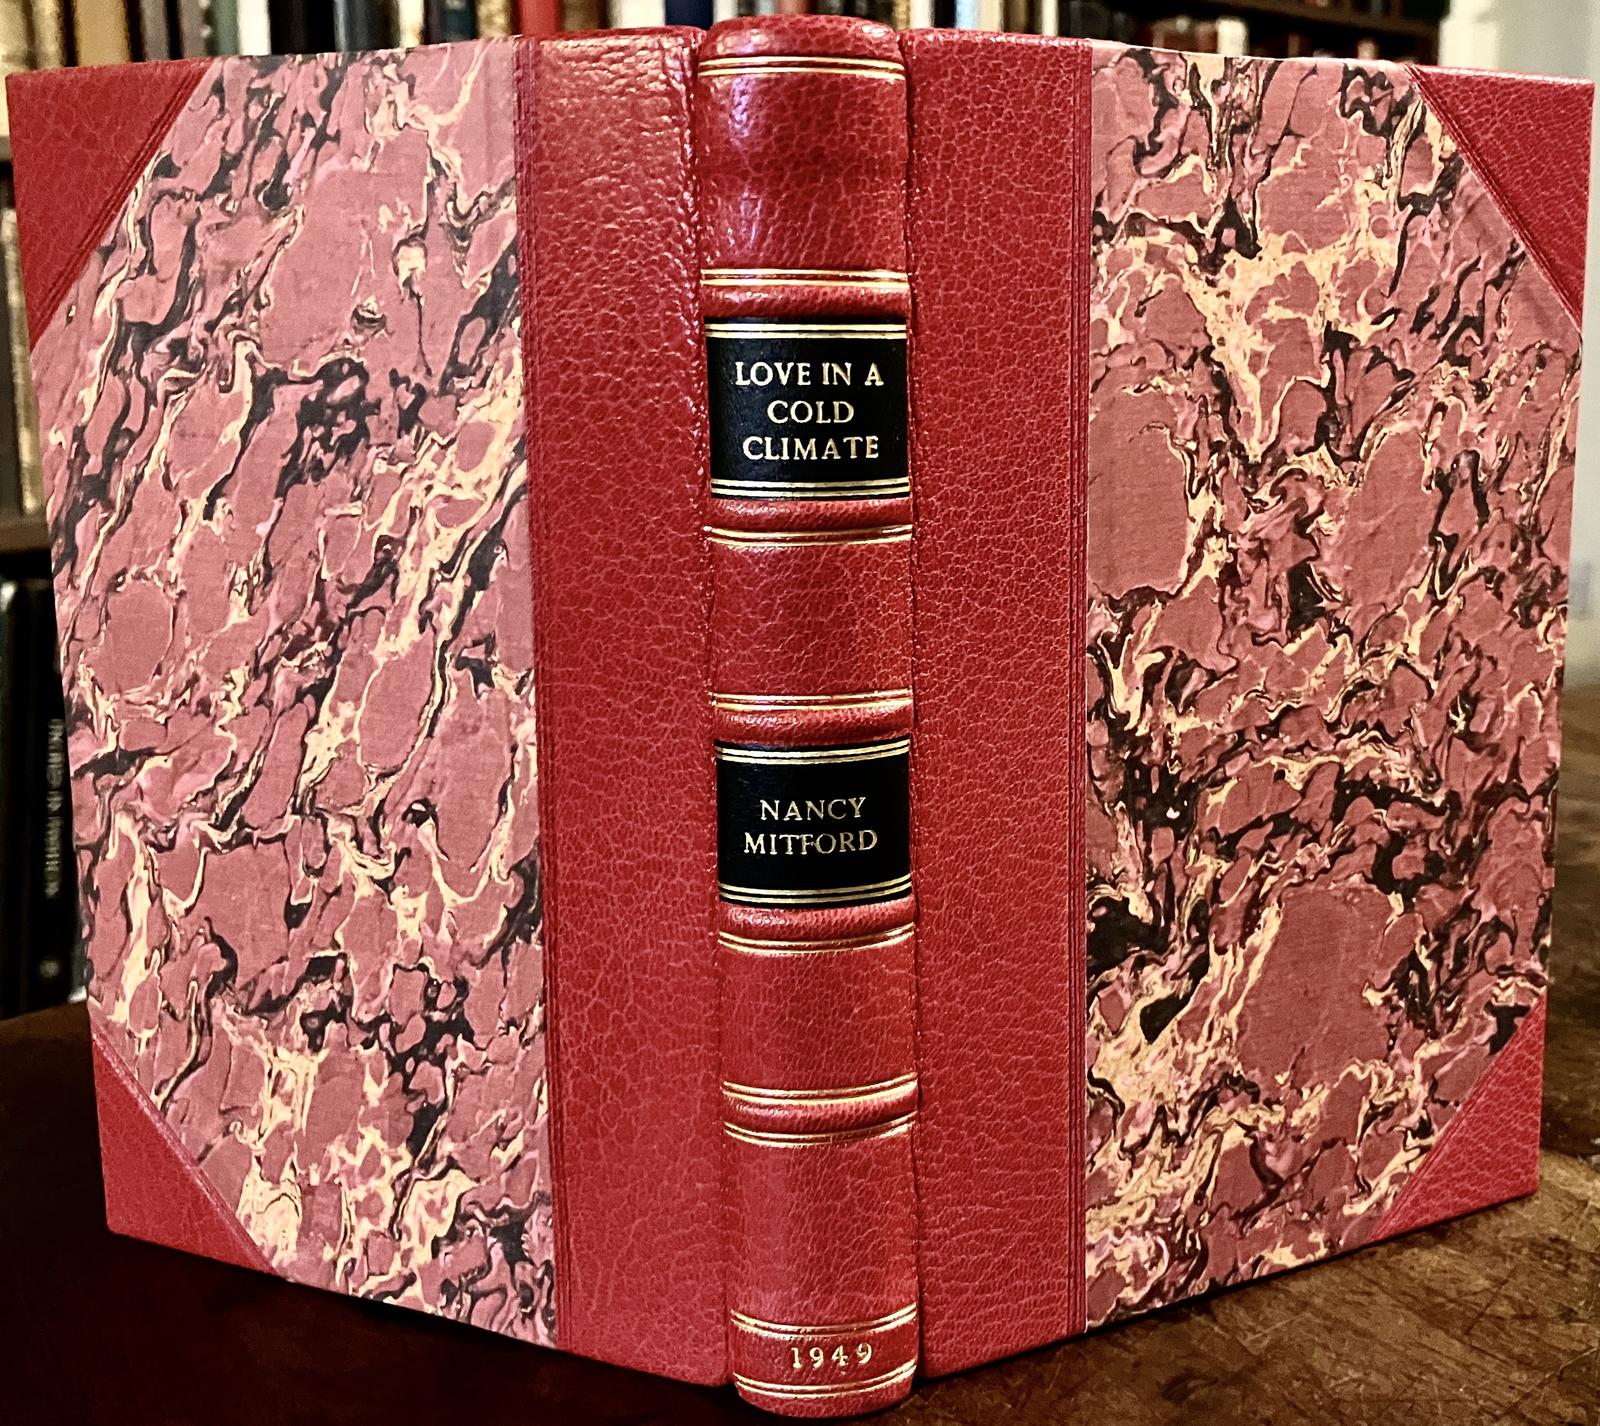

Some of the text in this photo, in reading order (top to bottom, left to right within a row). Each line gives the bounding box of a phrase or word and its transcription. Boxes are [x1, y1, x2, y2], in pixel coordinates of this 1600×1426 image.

[735, 361, 885, 386] LOVE IN A
[767, 400, 854, 424] COLD
[742, 436, 879, 460] CLIMATE
[760, 796, 867, 821] NANCY
[743, 830, 878, 855] MITFORD
[791, 1343, 872, 1368] 1949
